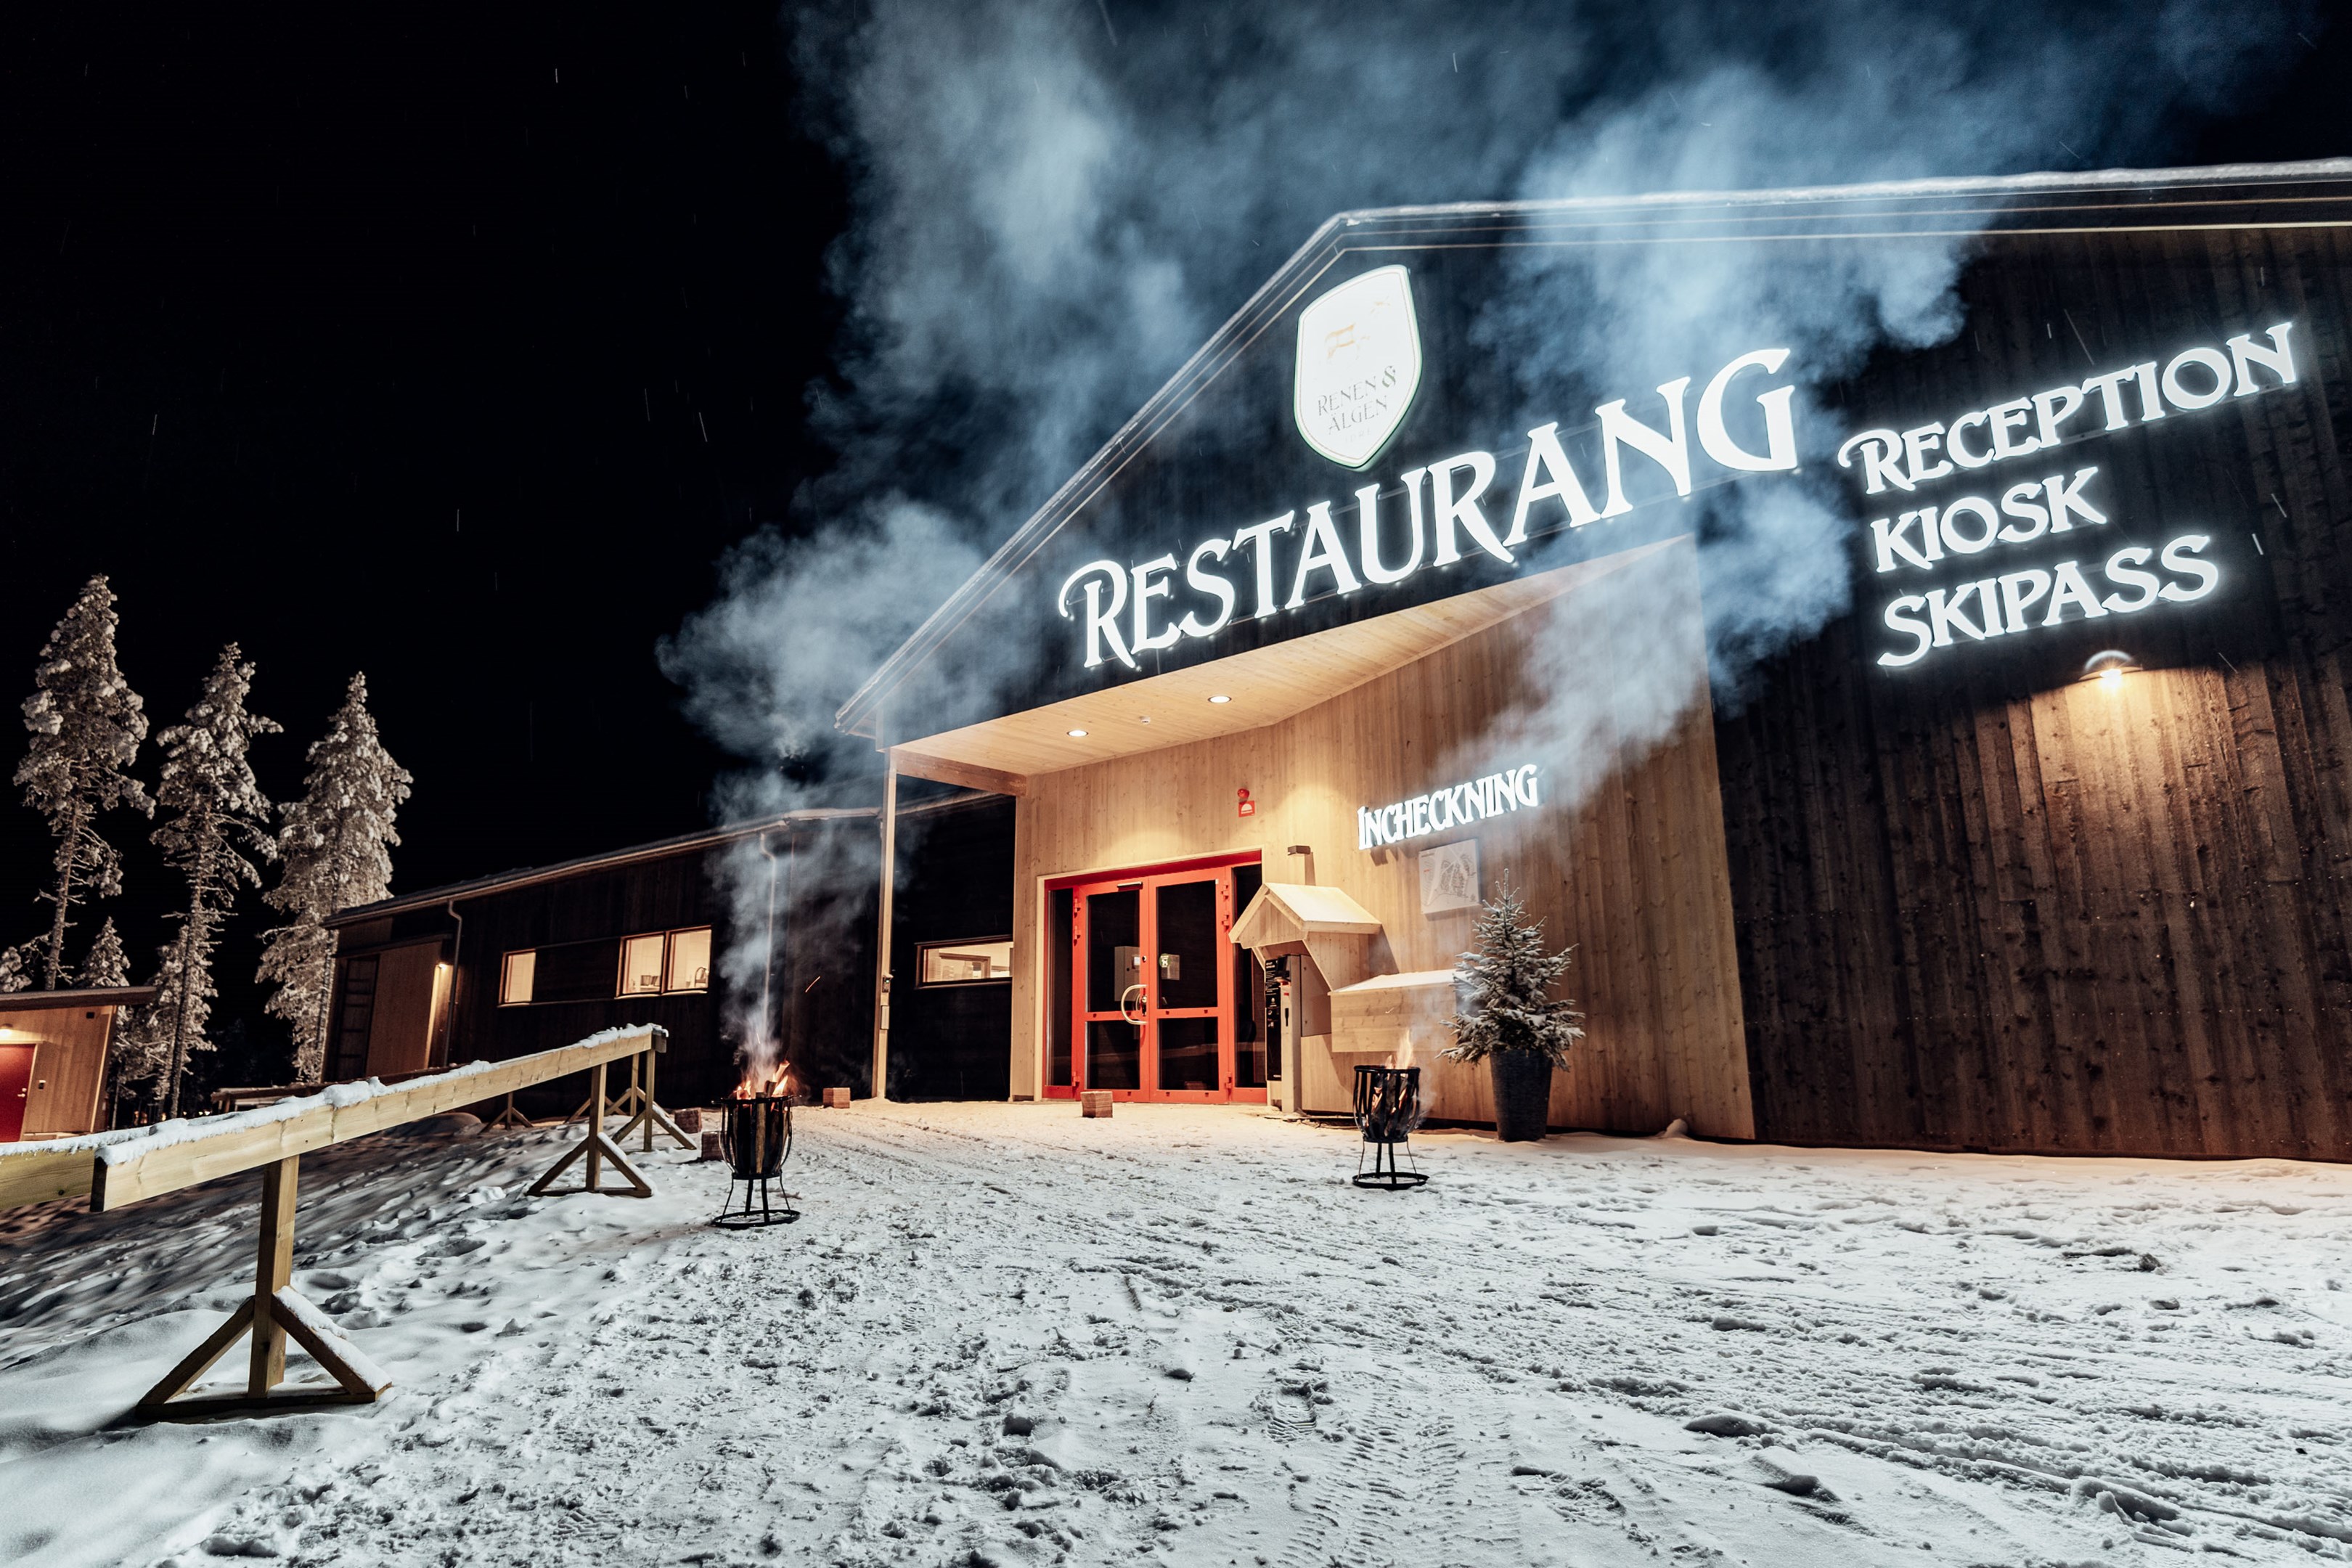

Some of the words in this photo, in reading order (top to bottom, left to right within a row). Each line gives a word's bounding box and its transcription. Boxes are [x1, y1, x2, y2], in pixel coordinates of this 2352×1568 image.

[1318, 375, 1377, 416] RENEN
[1381, 365, 1396, 388] &
[1328, 395, 1388, 436] ÄLGEN
[1837, 322, 2297, 494] RECEPTION
[1058, 348, 1797, 669] RESTAURANG
[1870, 467, 2107, 573] KIOSK
[1877, 535, 2218, 666] SKIPASS
[1357, 764, 1539, 850] INCHECKNING
